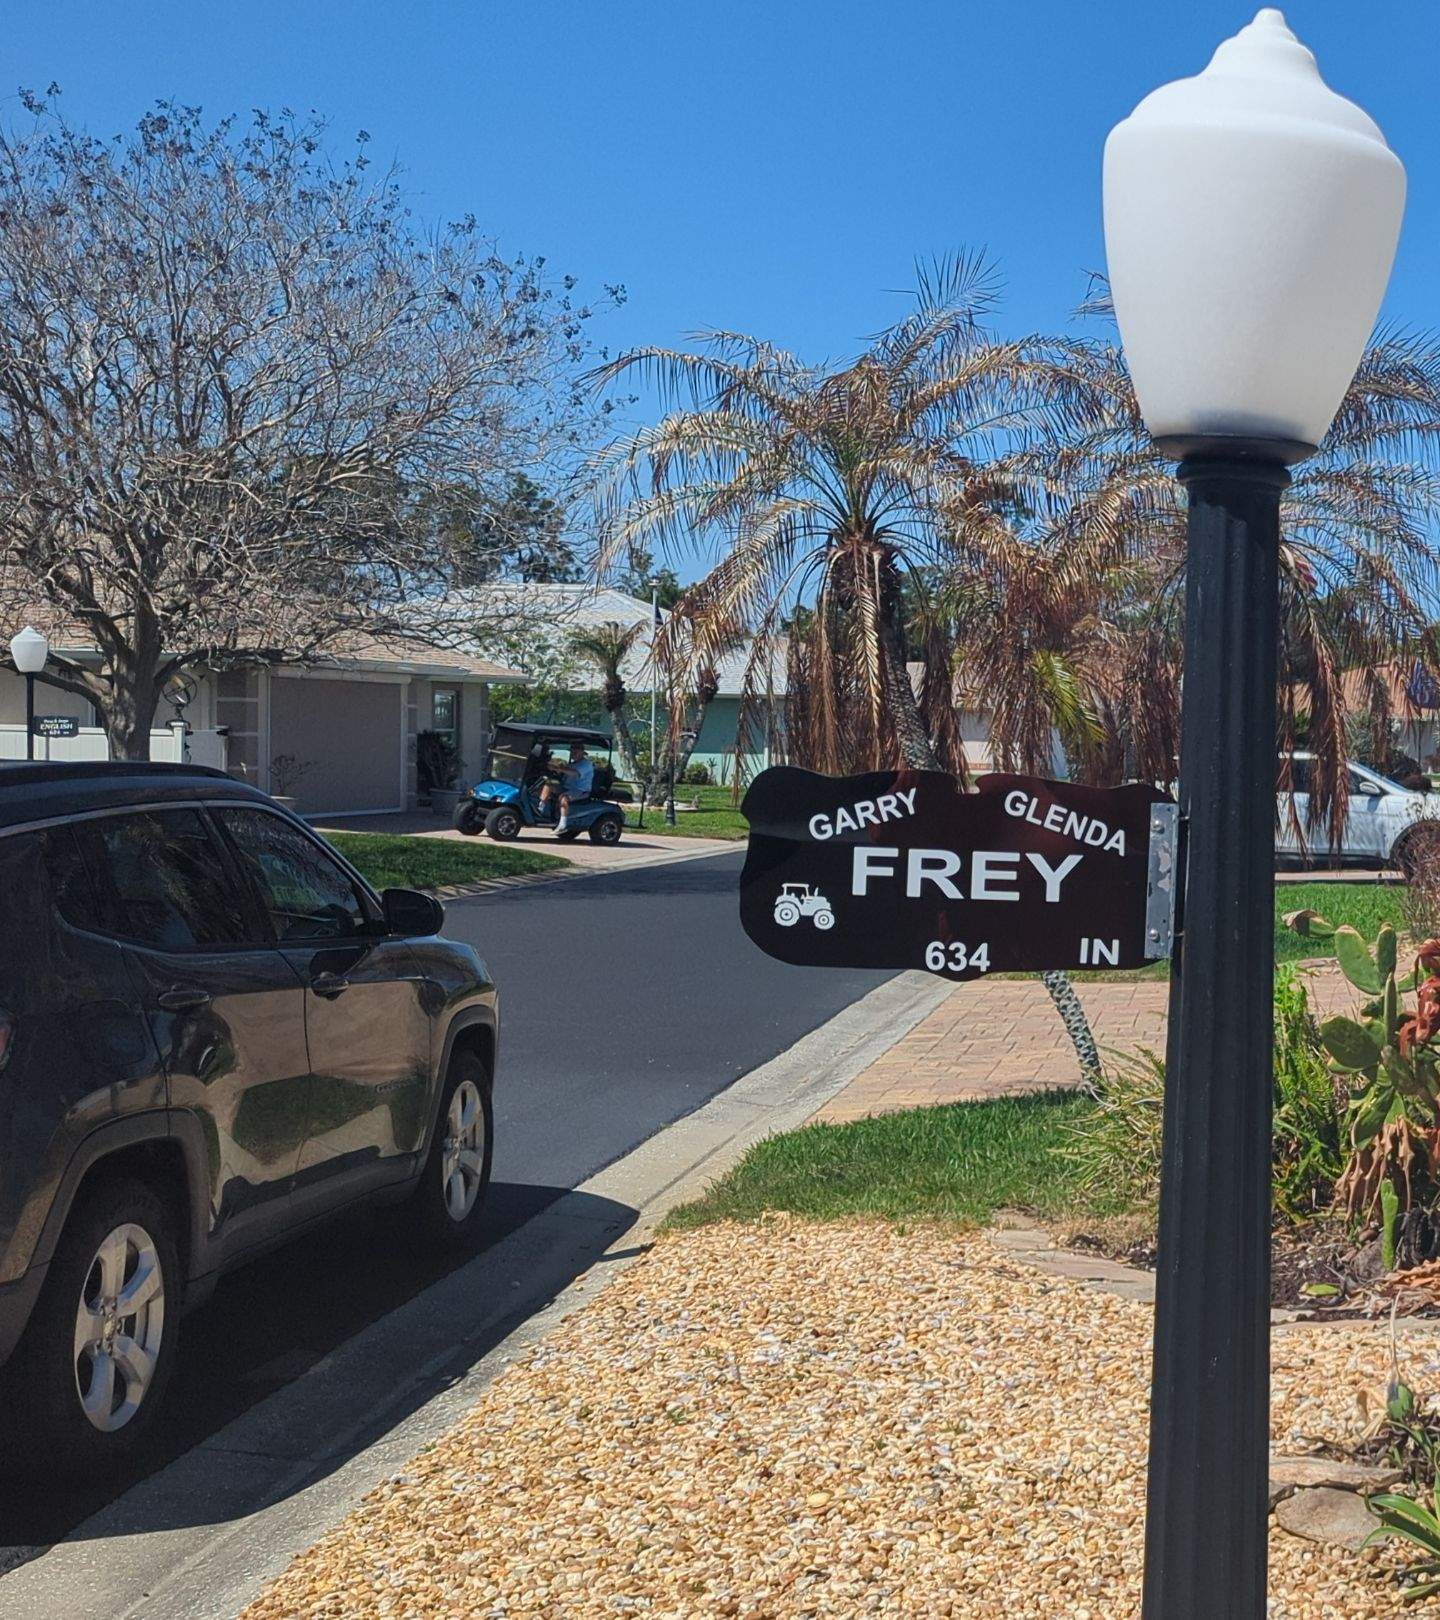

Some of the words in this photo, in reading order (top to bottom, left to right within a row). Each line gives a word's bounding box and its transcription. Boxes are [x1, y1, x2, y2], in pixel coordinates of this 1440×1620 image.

[808, 787, 918, 841] GARRY
[1004, 789, 1127, 857] GLENDA
[851, 846, 1084, 903] FREY
[925, 941, 991, 973] 634
[1079, 938, 1120, 966] IN
